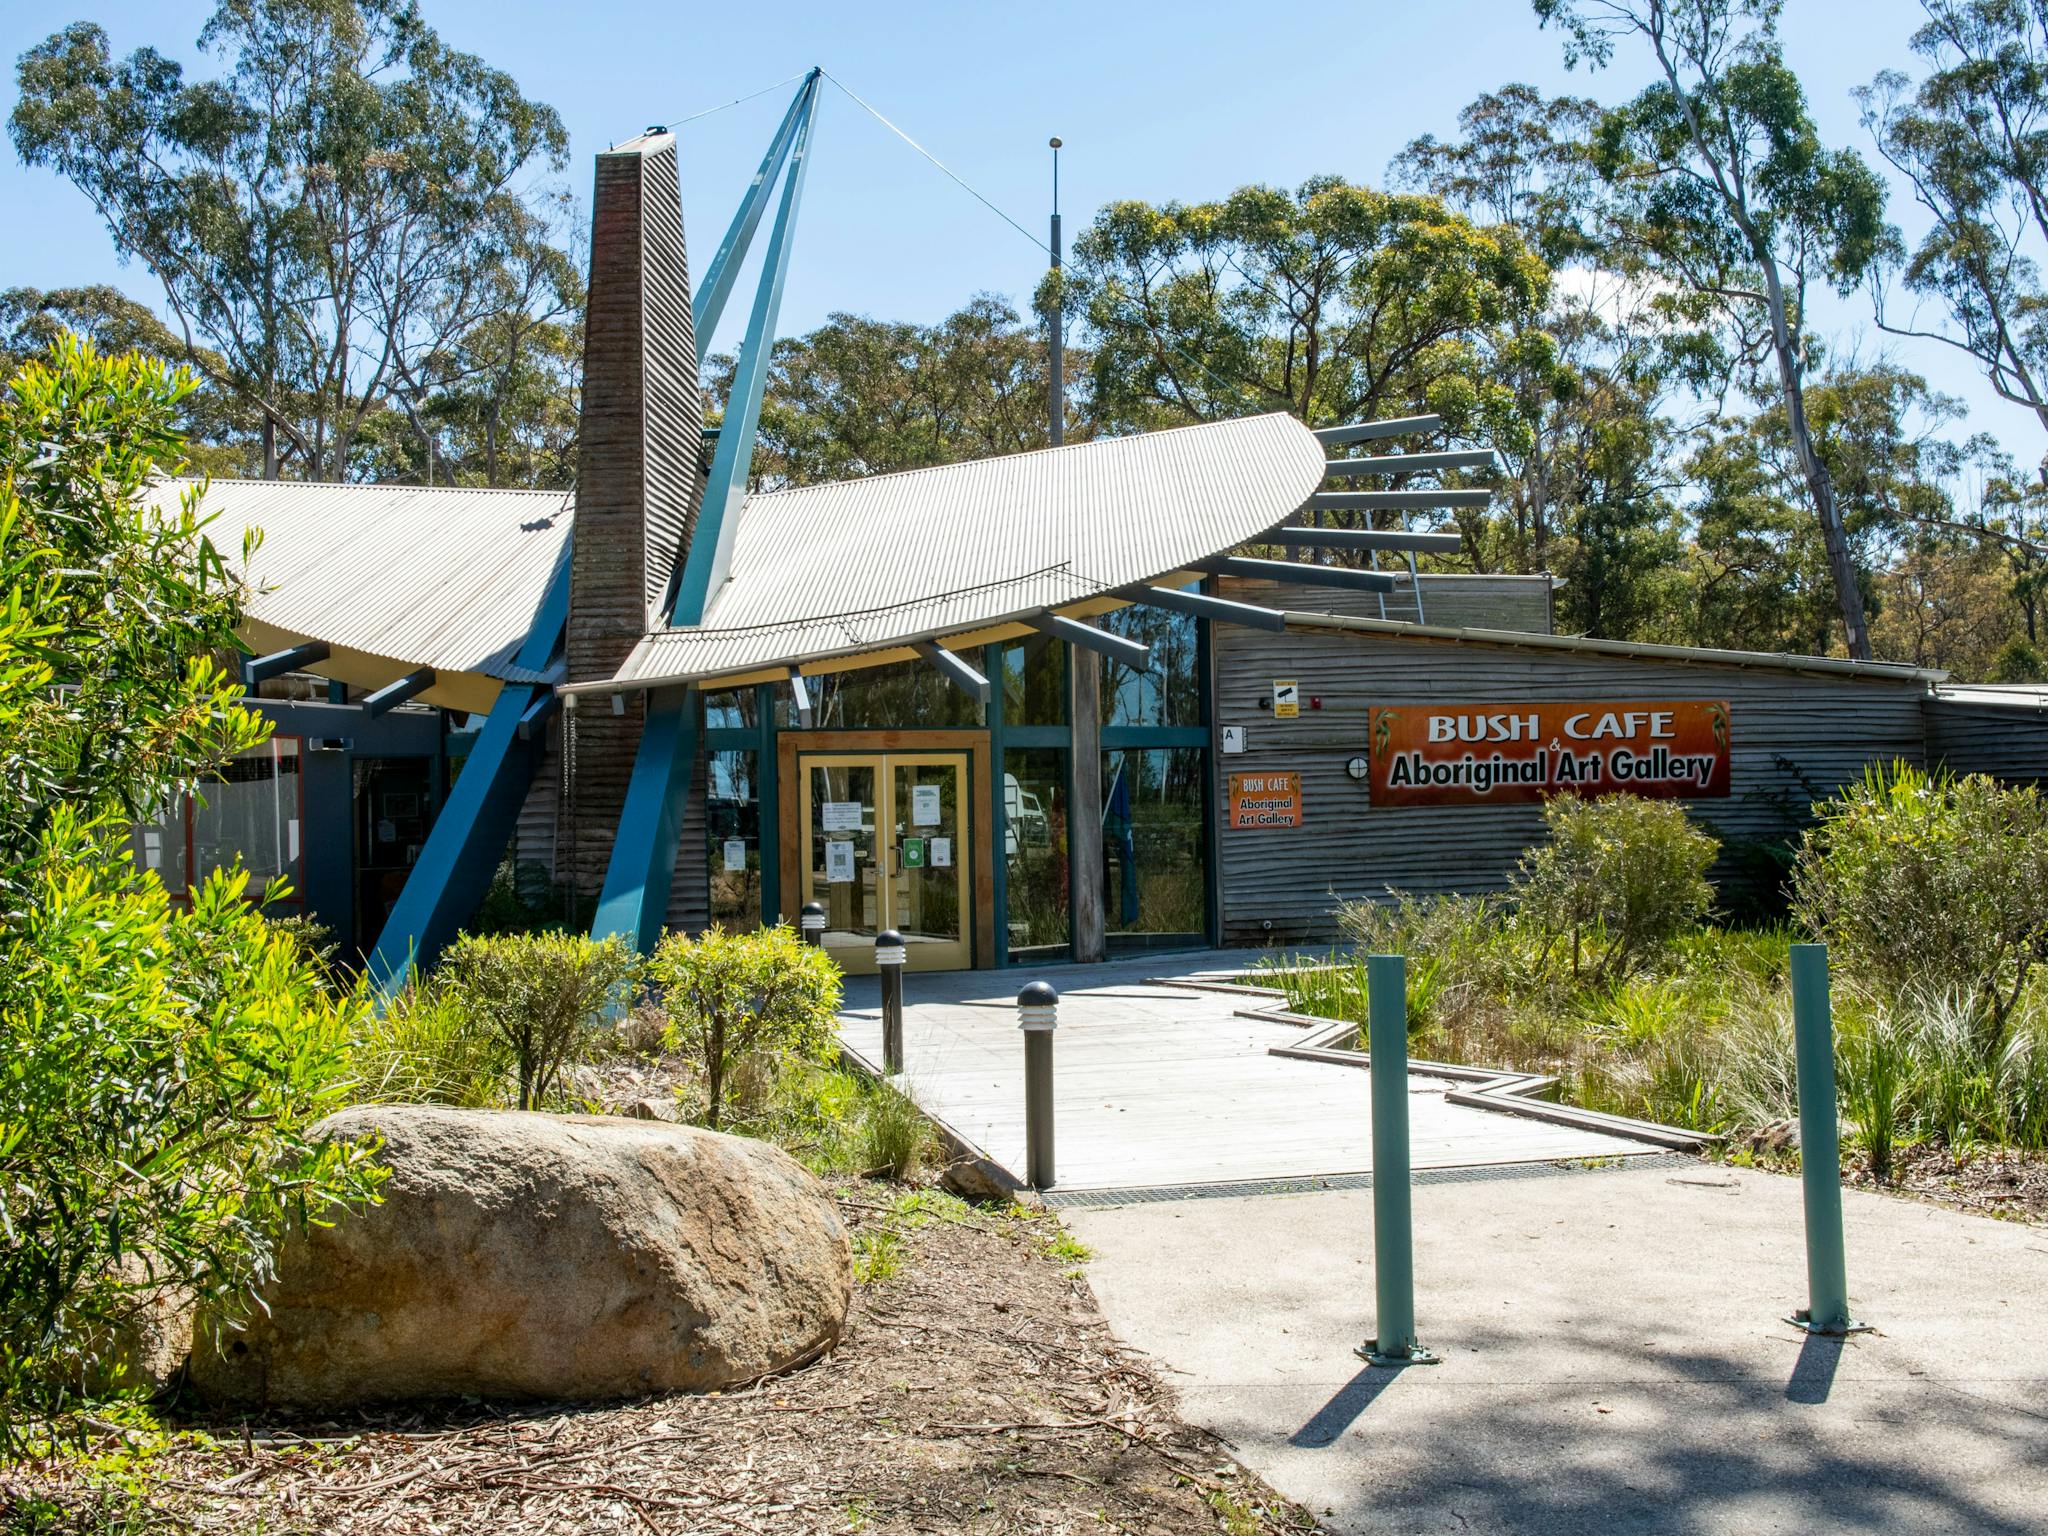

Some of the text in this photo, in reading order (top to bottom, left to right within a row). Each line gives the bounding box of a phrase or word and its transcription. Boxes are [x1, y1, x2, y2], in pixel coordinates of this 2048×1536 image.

[1225, 729, 1234, 740] A
[1428, 711, 1676, 743] BUSH CAFE
[1550, 737, 1561, 751] &
[1390, 748, 1714, 792] Aboriginal Art Gallery
[1243, 777, 1289, 792] BUSH CAFE
[1240, 796, 1294, 826] Aboriginal Art Gallery
